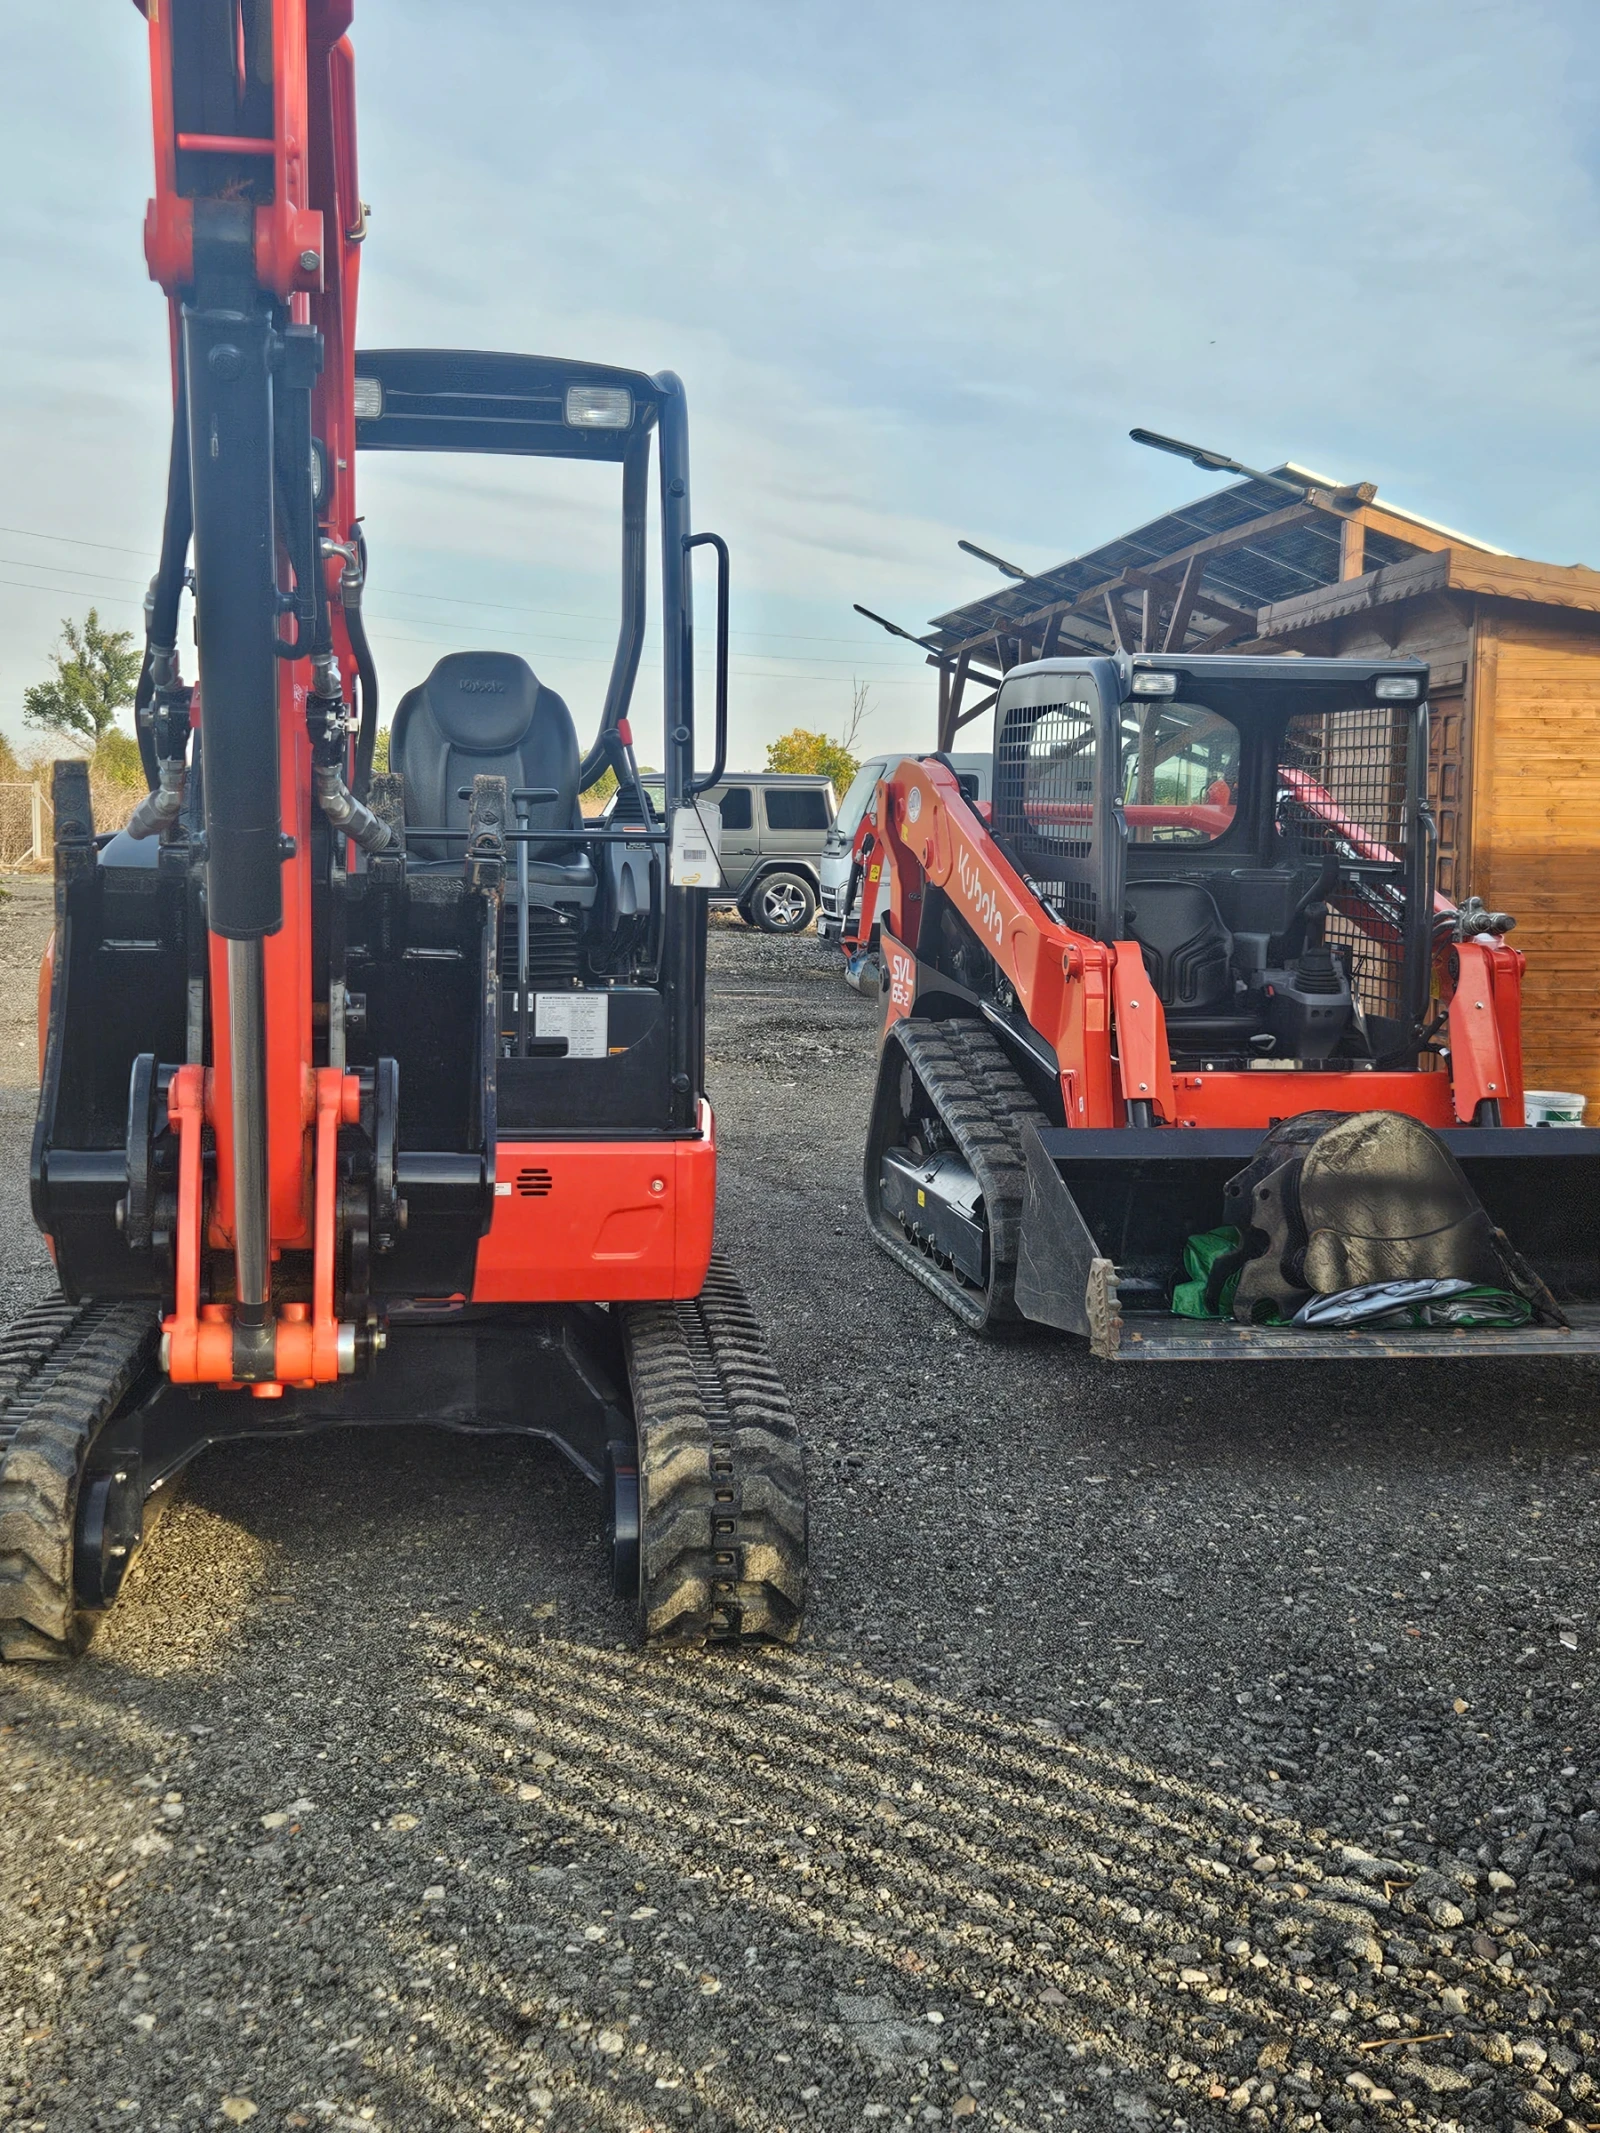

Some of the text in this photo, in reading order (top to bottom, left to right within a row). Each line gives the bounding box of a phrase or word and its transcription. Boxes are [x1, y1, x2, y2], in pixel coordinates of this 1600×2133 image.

[958, 844, 1003, 946] Kubota
[891, 954, 914, 986] SVL
[892, 982, 910, 1007] 65-2
